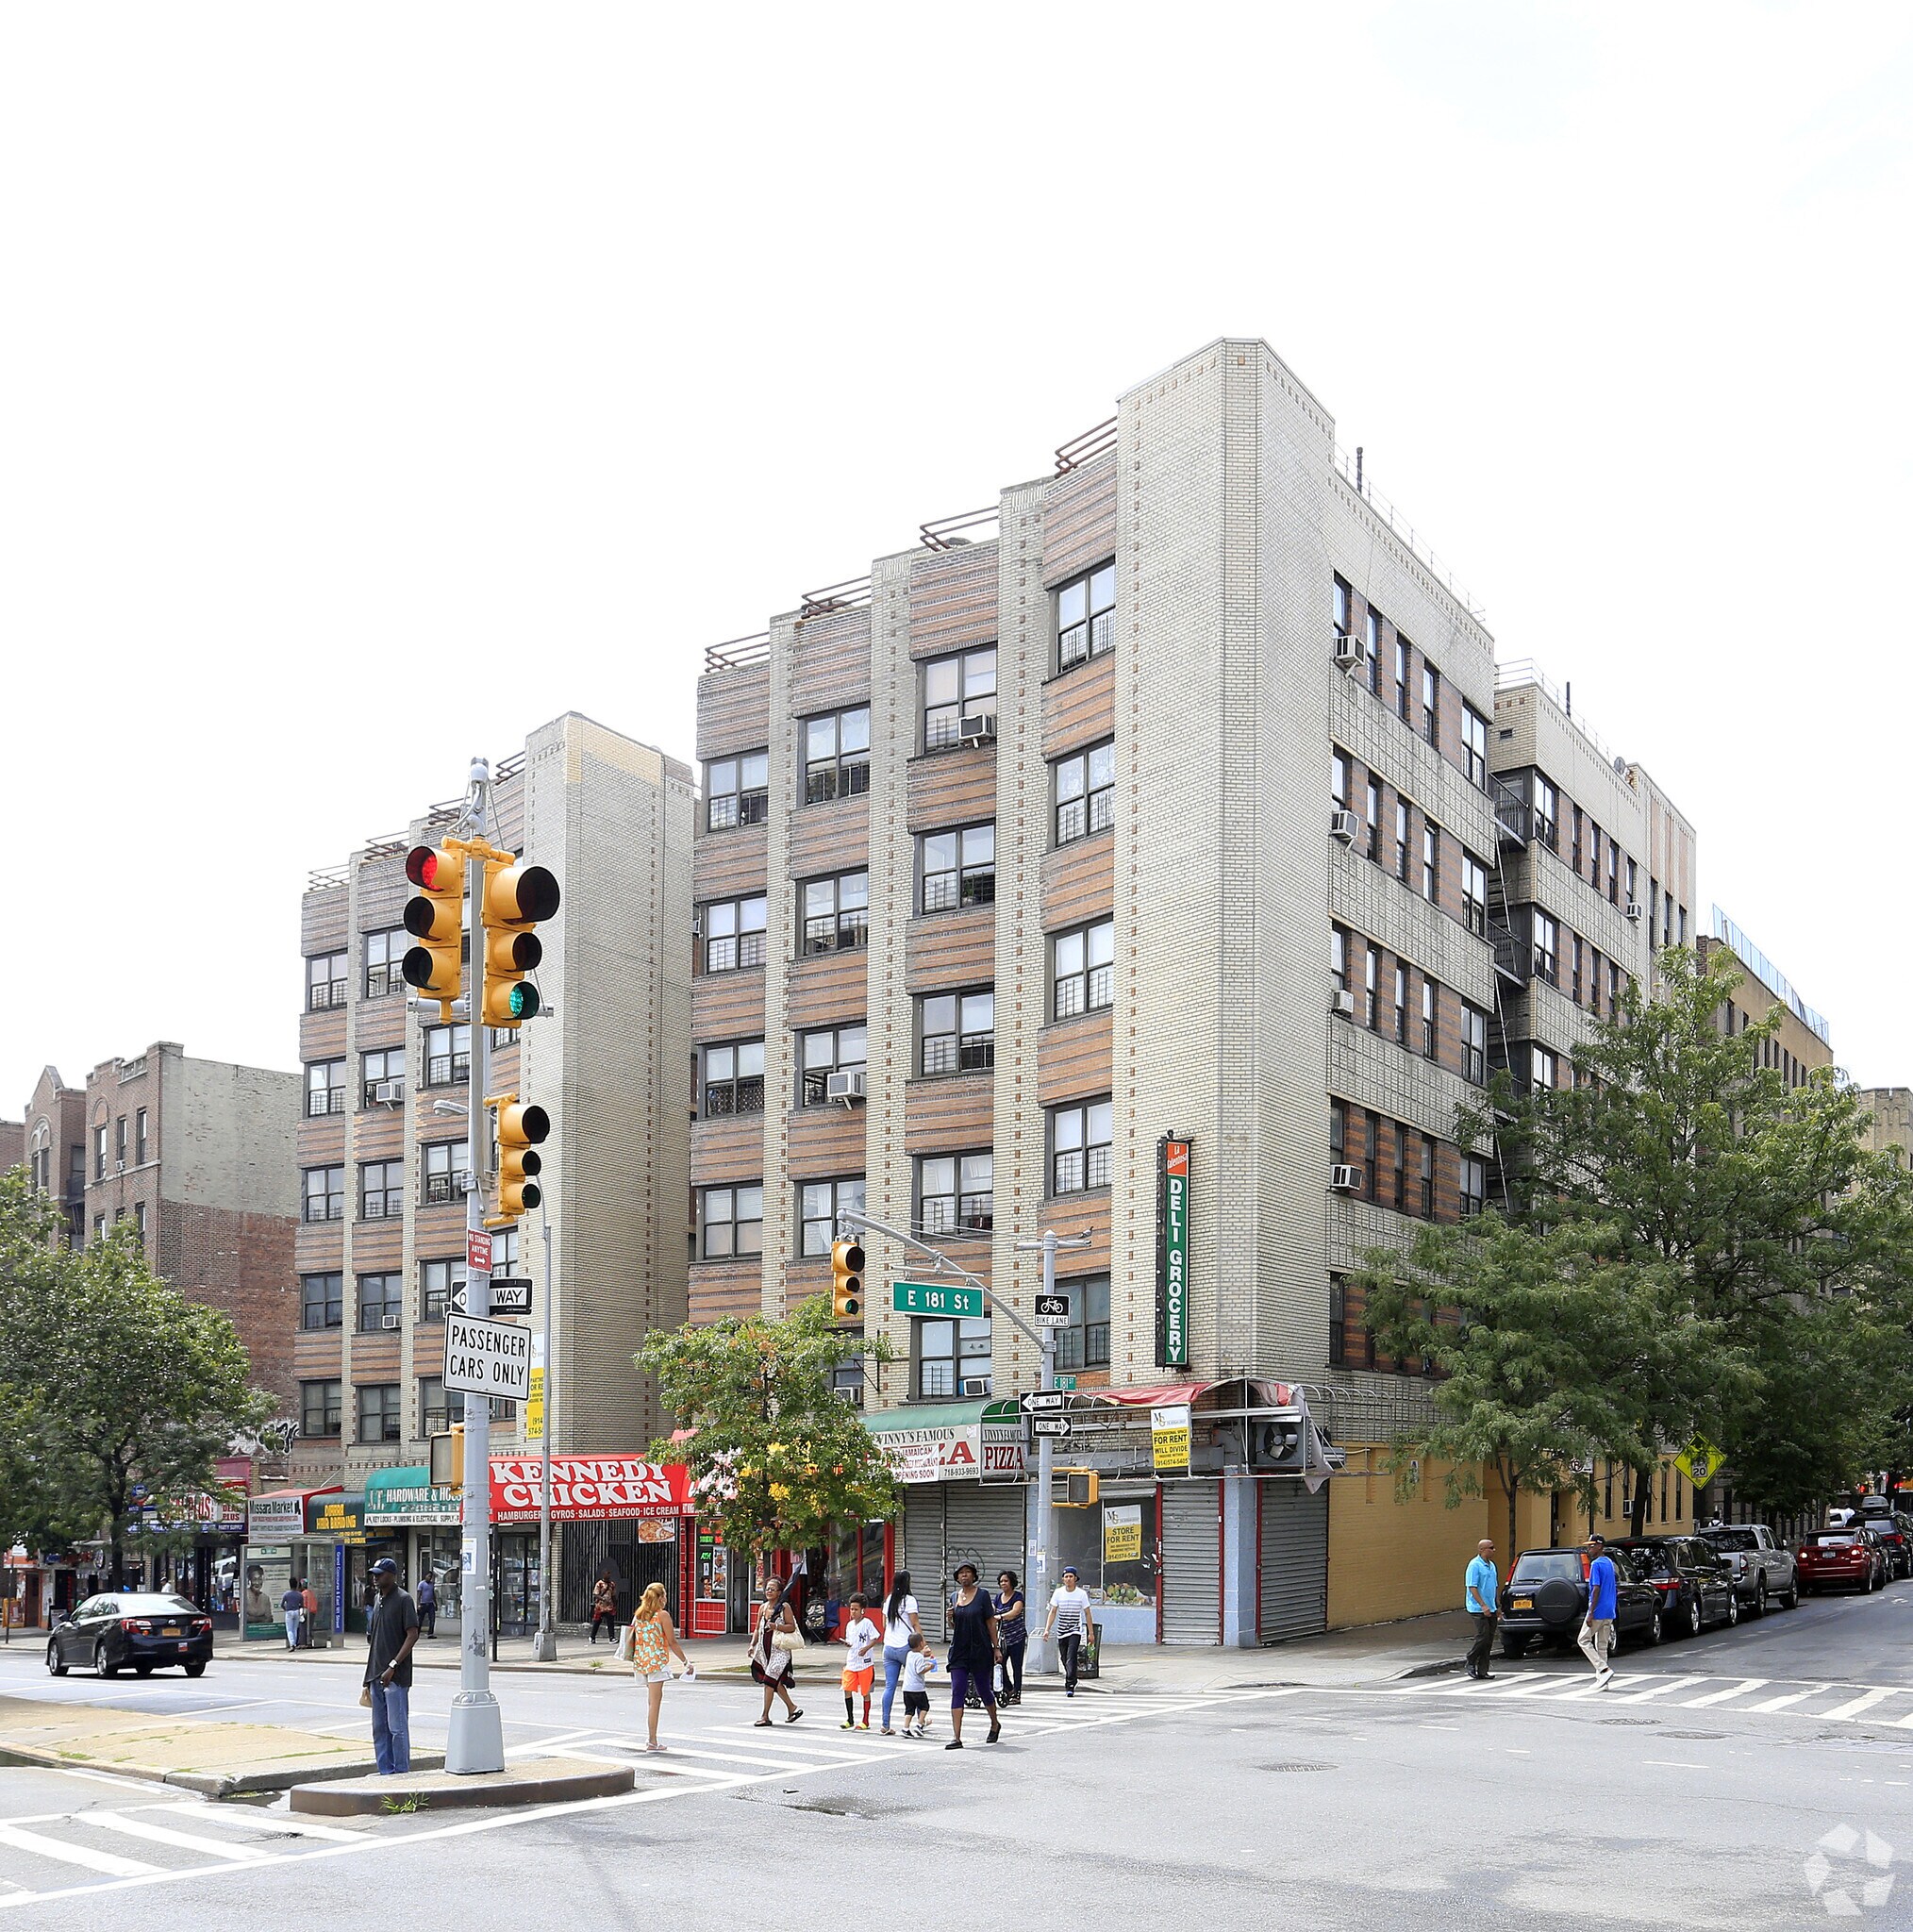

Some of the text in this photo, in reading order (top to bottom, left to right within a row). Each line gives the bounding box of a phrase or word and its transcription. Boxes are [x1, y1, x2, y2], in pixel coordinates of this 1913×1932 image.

[468, 1233, 491, 1246] NO STANDING
[471, 1245, 489, 1256] ANYTIME
[1168, 1178, 1183, 1362] DELI GROCERY
[495, 1290, 524, 1304] WAY
[907, 1290, 969, 1310] E 181 St
[1036, 1315, 1068, 1325] BIKE LANE
[452, 1324, 525, 1358] PASSENGER
[450, 1355, 525, 1386] CARS ONLY
[1054, 1376, 1058, 1389] E
[1027, 1396, 1059, 1407] ONE WAY
[1038, 1422, 1066, 1431] ONE WAY
[876, 1427, 956, 1445] VINNY'S FAMOUS
[1154, 1434, 1188, 1445] FOR RENT
[984, 1446, 1024, 1471] PIZZA
[490, 1460, 666, 1484] KENNEDY
[919, 1469, 935, 1479] SOON
[1693, 1467, 1705, 1476] 20
[386, 1488, 429, 1503] HARDWARE
[431, 1487, 438, 1502] &
[503, 1480, 673, 1507] CHICKEN
[272, 1500, 293, 1514] Market
[497, 1510, 541, 1521] HAMBURGER
[551, 1509, 575, 1520] GYROS
[577, 1508, 606, 1519] SALADS
[608, 1507, 640, 1517] SEAFOOD
[643, 1506, 655, 1516] ICE
[656, 1506, 679, 1516] CREAM
[223, 1513, 240, 1522] PLUS
[1112, 1526, 1134, 1536] STORE
[1106, 1534, 1139, 1544] FOR RENT
